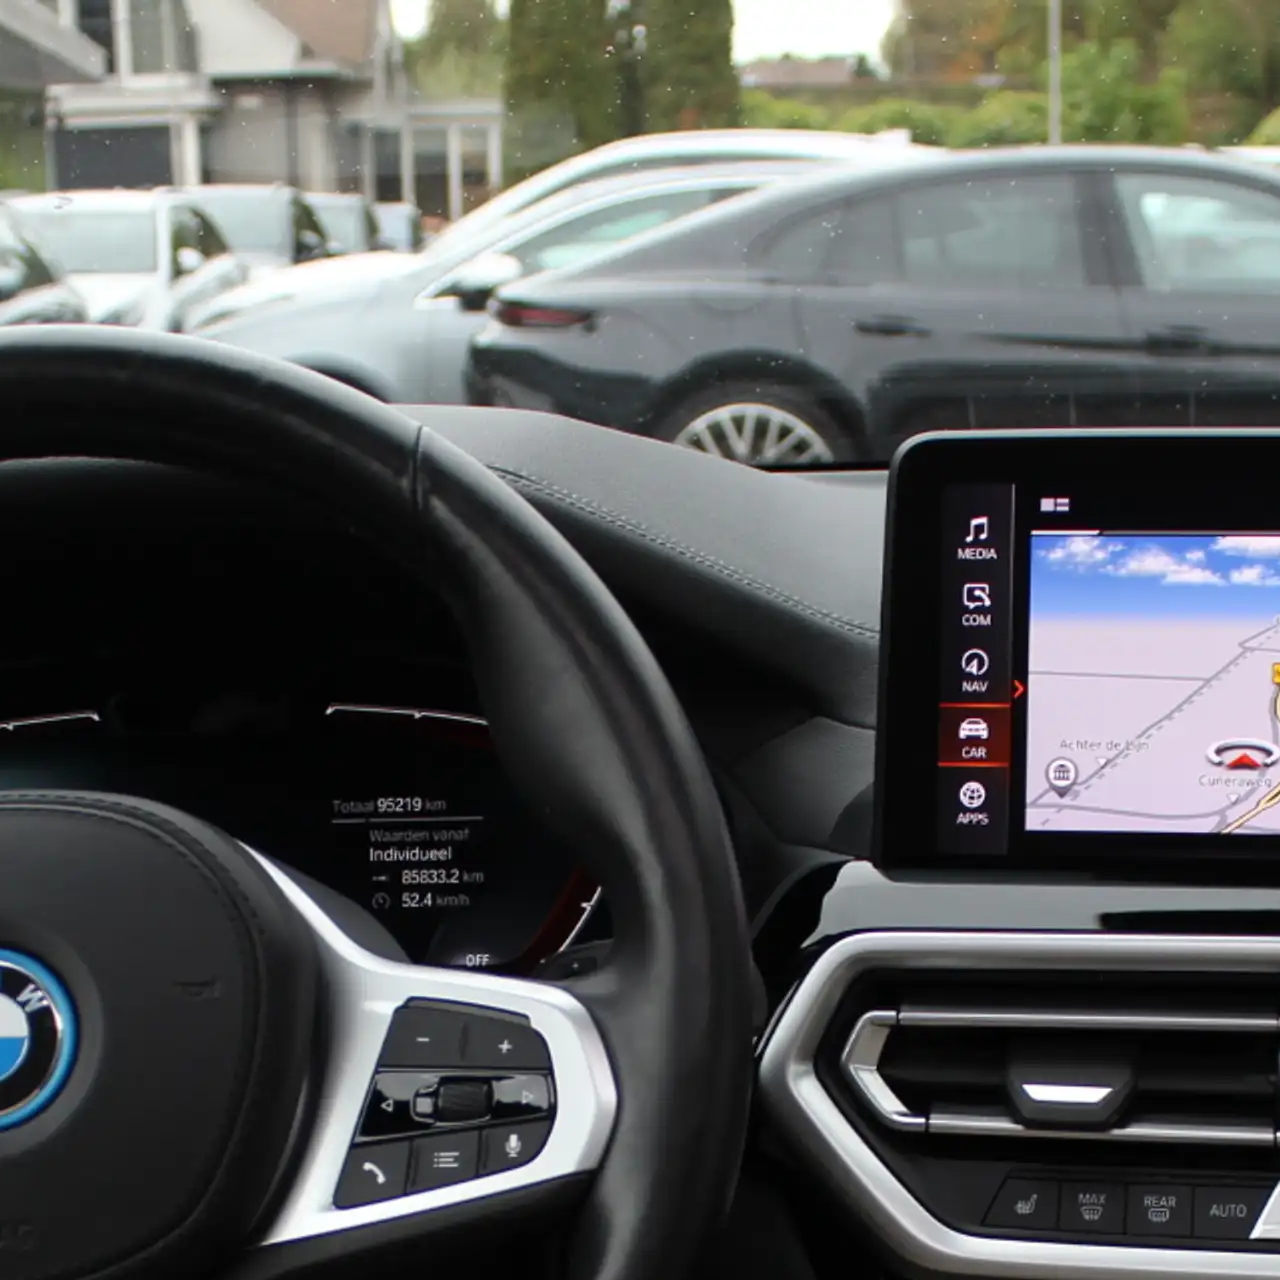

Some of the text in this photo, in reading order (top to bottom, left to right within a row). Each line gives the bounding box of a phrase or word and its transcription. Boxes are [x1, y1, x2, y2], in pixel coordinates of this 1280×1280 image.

[957, 547, 997, 560] MEDIA
[962, 613, 991, 626] COM
[962, 680, 990, 693] NAV
[1060, 738, 1099, 751] Achter
[1104, 738, 1121, 751] de
[961, 746, 987, 759] CAR
[1198, 774, 1272, 789] Cuneraweg
[332, 798, 446, 814] Totaal 95219 km
[956, 813, 989, 825] APPS
[369, 828, 469, 842] Waarden vanaf
[369, 846, 452, 861] Individueel
[402, 869, 484, 884] 85833.2 km
[402, 892, 432, 907] 52.4
[465, 954, 490, 967] OFF
[1078, 1194, 1106, 1205] MAX
[1144, 1196, 1176, 1208] REAR
[1210, 1204, 1247, 1217] AUTO
